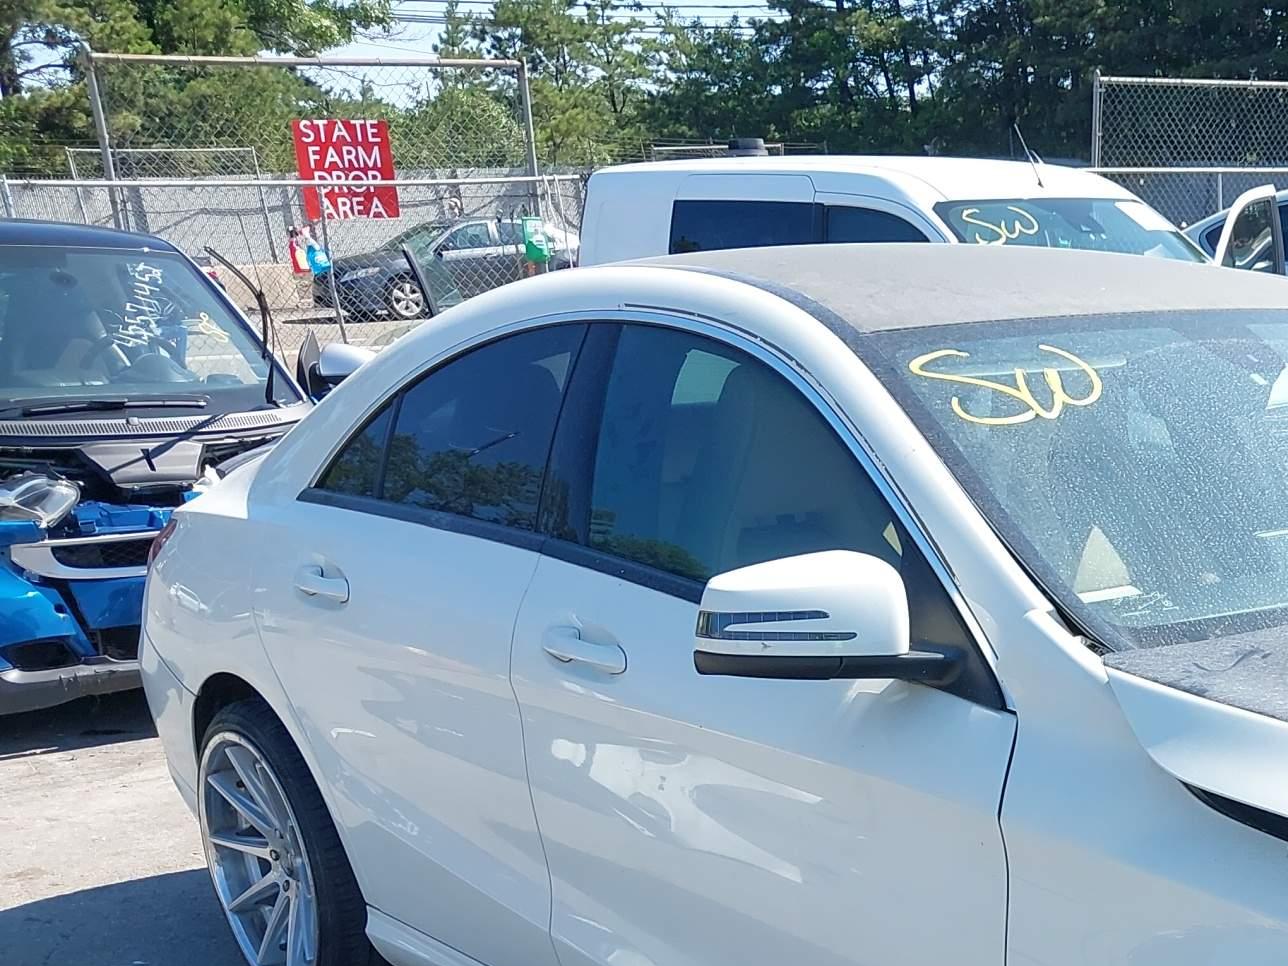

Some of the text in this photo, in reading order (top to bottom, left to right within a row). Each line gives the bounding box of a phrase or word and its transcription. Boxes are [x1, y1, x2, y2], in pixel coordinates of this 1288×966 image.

[299, 119, 381, 143] STATE
[307, 145, 382, 168] FARM
[313, 170, 382, 193] DROP
[322, 196, 389, 220] AREA
